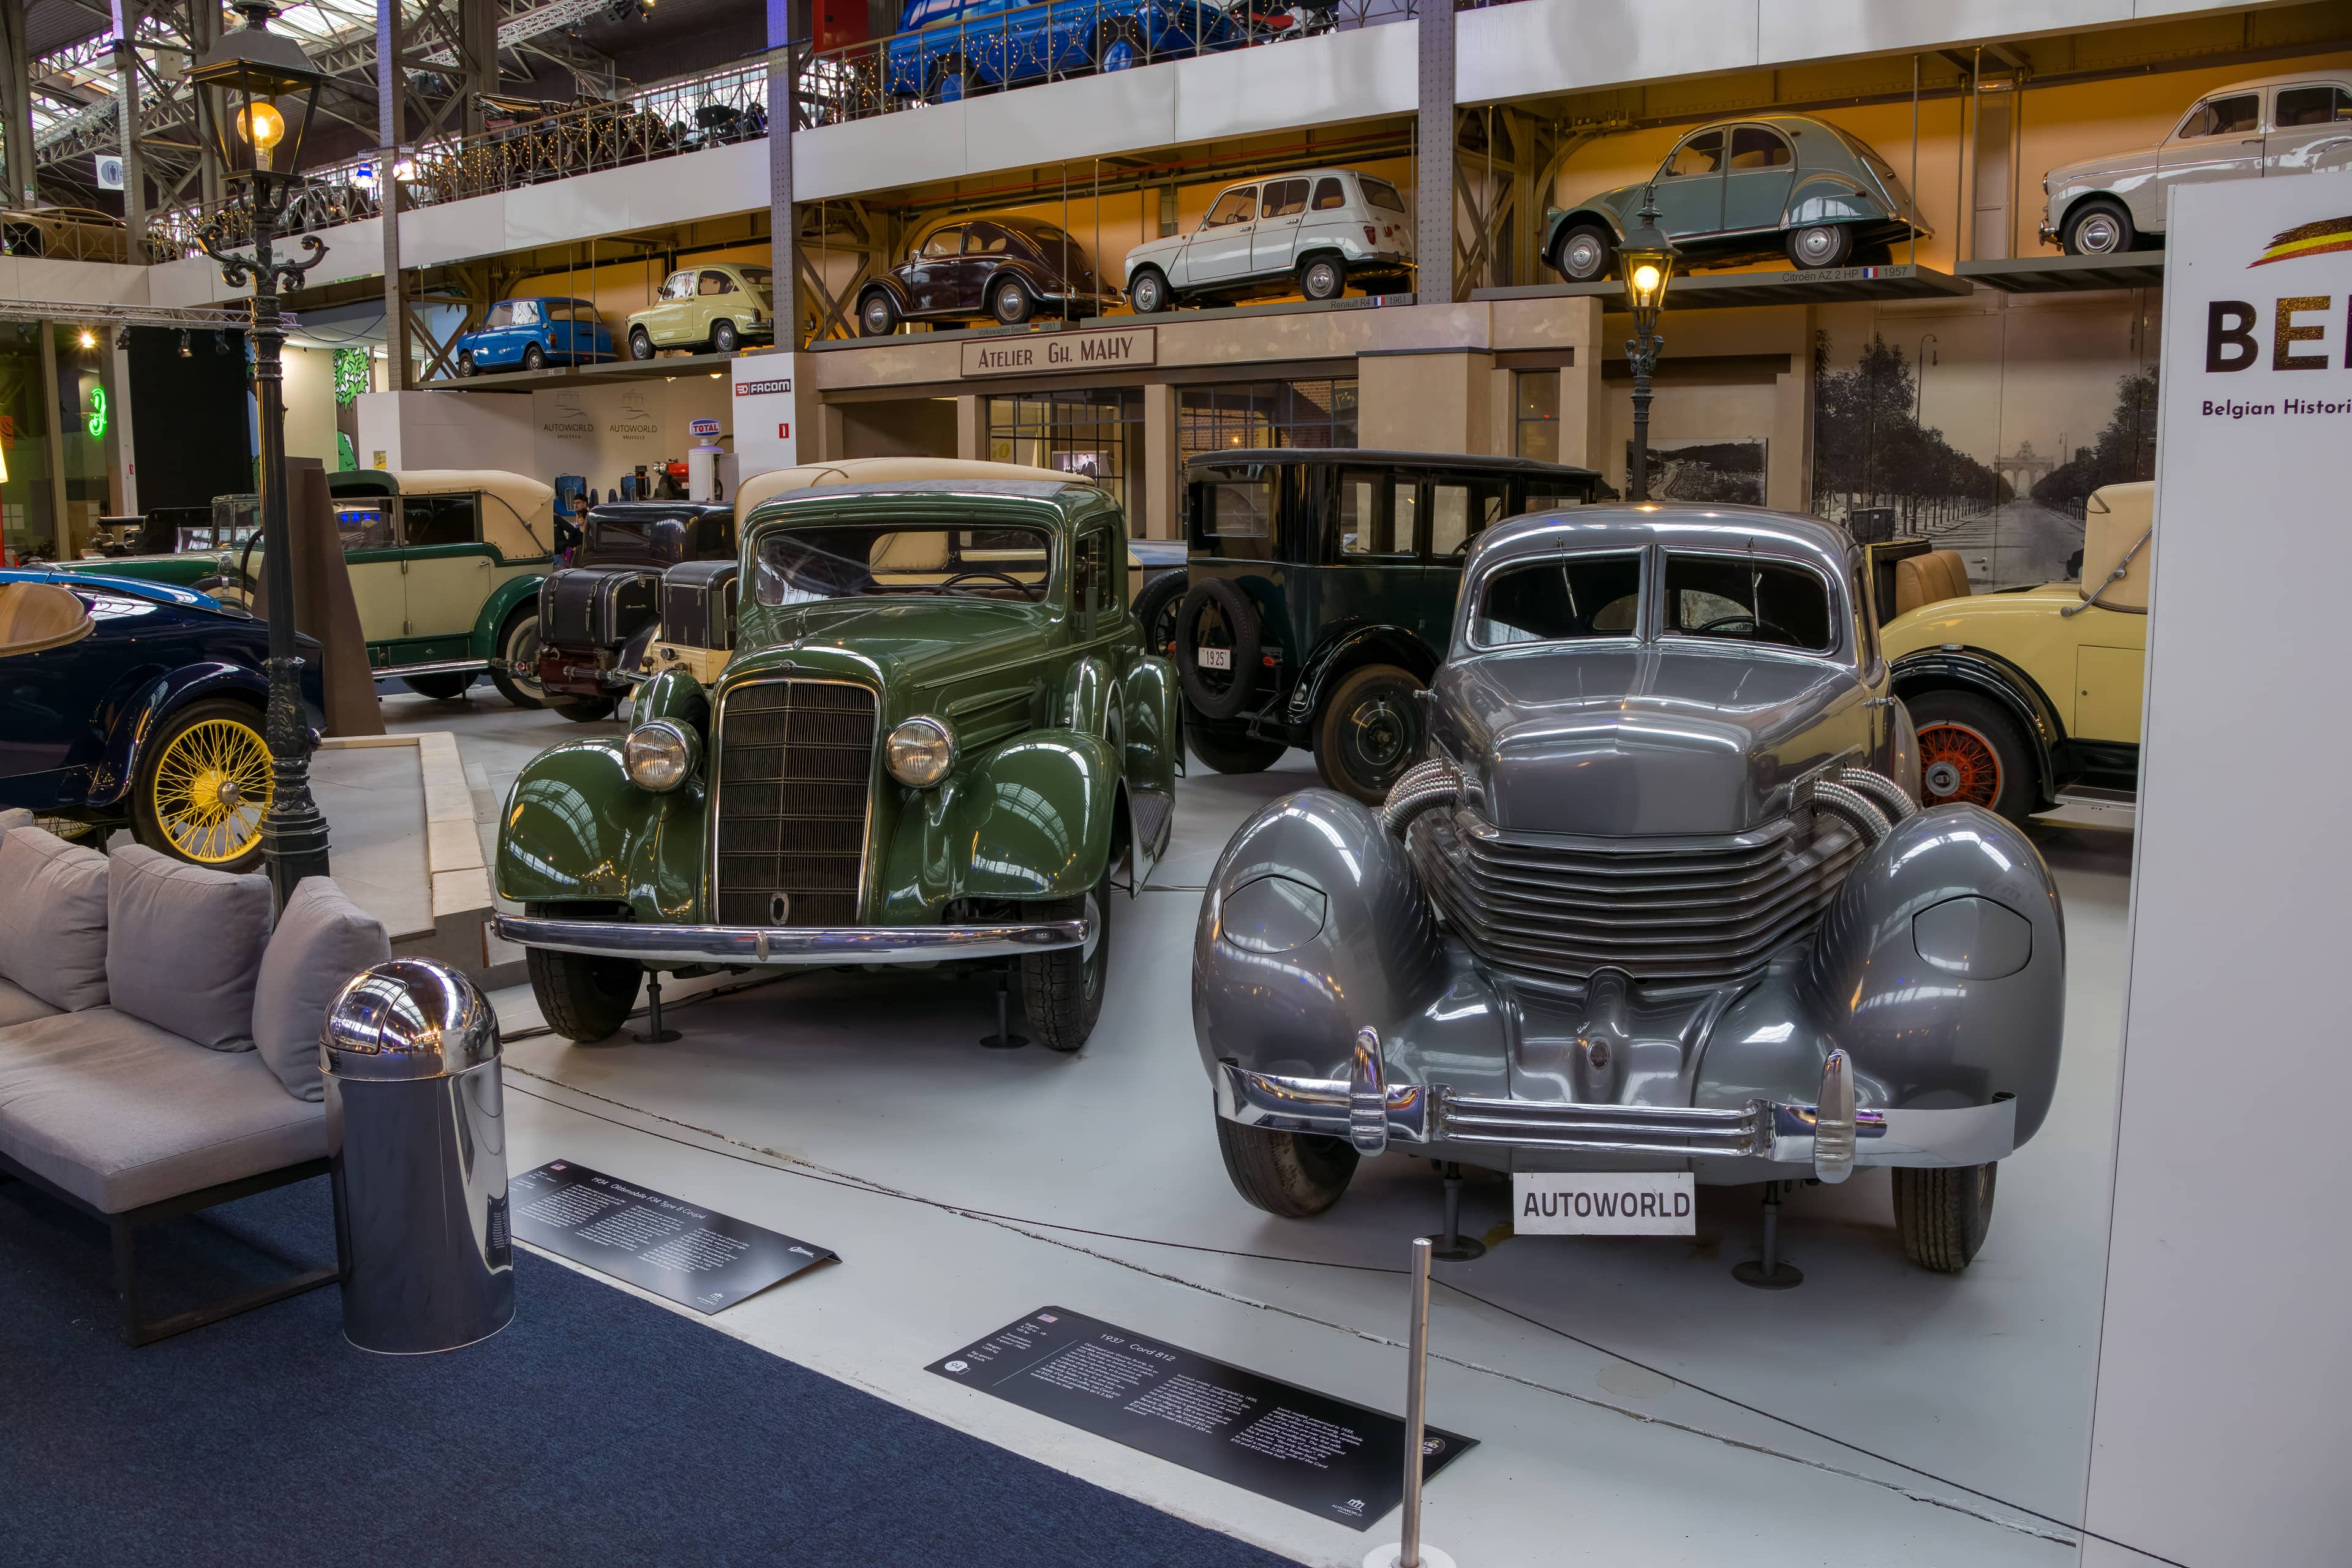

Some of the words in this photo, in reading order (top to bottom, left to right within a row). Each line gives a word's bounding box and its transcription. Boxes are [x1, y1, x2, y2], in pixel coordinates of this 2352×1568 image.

[1782, 271, 1816, 282] Citroën
[1819, 270, 1833, 281] AZ
[1835, 270, 1841, 279] 2
[1844, 269, 1858, 279] HP
[1883, 266, 1907, 277] 1957
[1331, 300, 1358, 309] Renault
[1360, 298, 1371, 307] R4
[1389, 295, 1406, 304] 1961
[978, 326, 1010, 337] Volkswagen
[1011, 324, 1029, 334] Beetle
[1042, 322, 1056, 331] 1951
[2206, 295, 2352, 373] BE
[1080, 336, 1133, 361] MAHY
[751, 381, 790, 393] FACOM
[2203, 399, 2275, 420] Belgian
[543, 423, 594, 432] AUTOWORLD
[609, 424, 657, 433] AUTOWORLD
[693, 423, 719, 433] TOTAL
[1206, 650, 1224, 666] 1925
[590, 1177, 609, 1186] 1934
[611, 1183, 647, 1200] Oldsmobile
[646, 1196, 660, 1204] F34
[659, 1200, 676, 1210] Type
[682, 1208, 707, 1220] Coupé
[1523, 1191, 1691, 1218] AUTOWORLD
[1101, 1333, 1125, 1345] 1937
[1129, 1343, 1156, 1355] Cord
[1155, 1352, 1176, 1362] 812
[1331, 1504, 1363, 1517] AUTOWORLD
